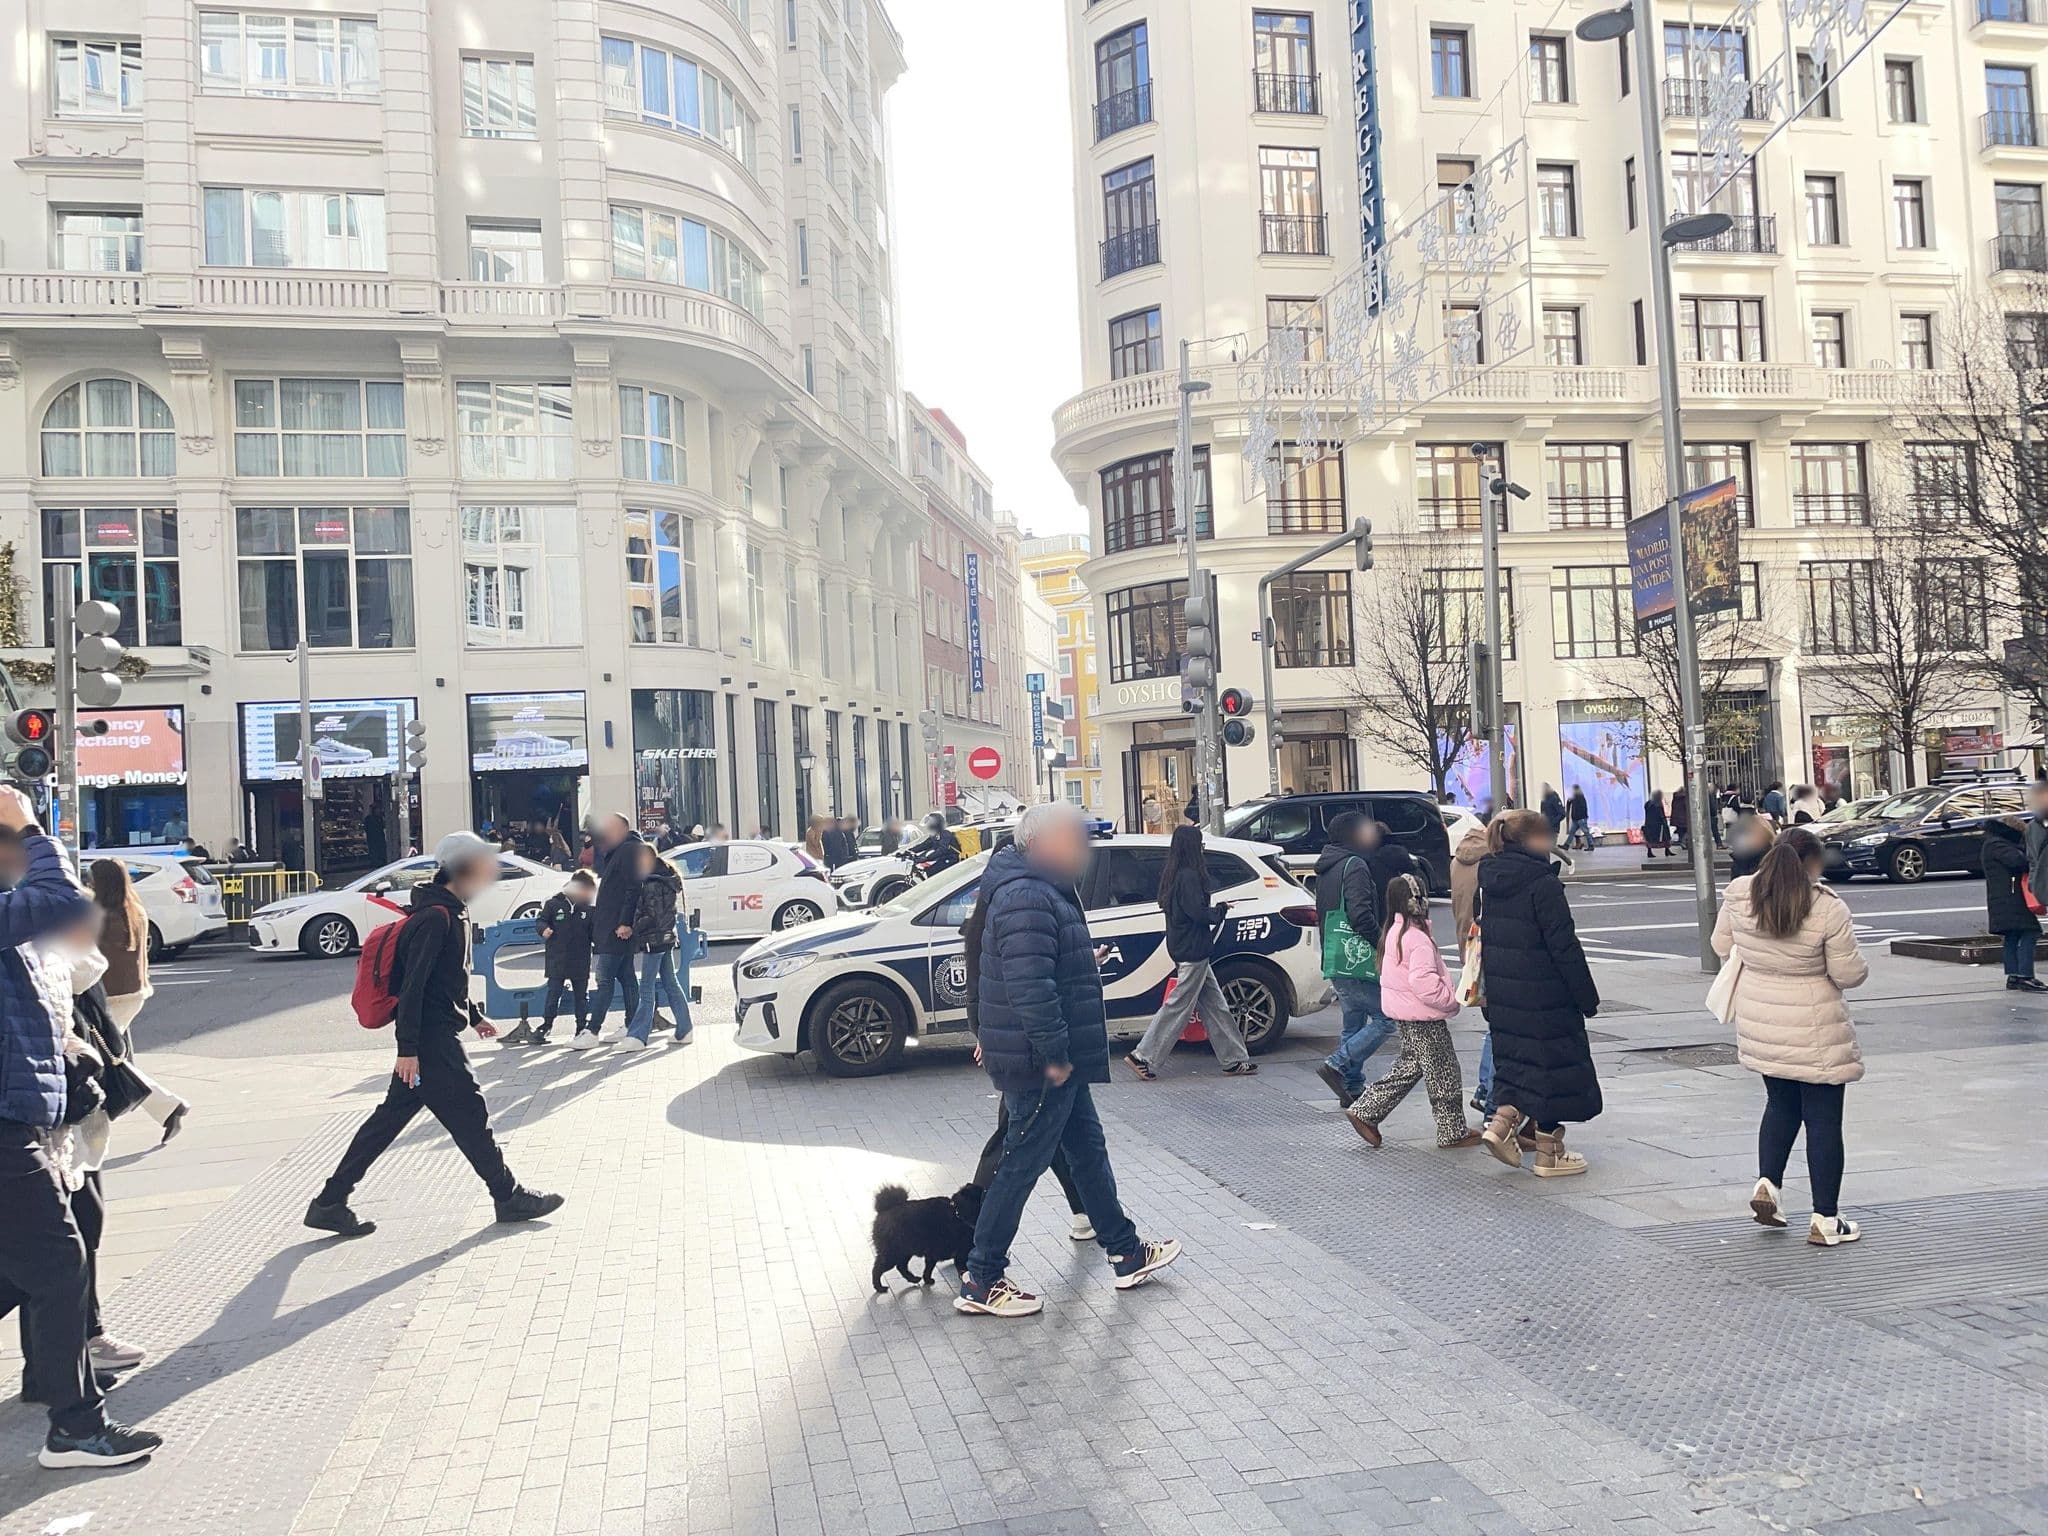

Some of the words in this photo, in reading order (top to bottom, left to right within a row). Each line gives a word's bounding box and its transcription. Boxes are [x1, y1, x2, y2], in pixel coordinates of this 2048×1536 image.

[1649, 554, 1671, 572] POST
[968, 557, 977, 607] HOTEL
[1637, 567, 1672, 590] NAVIDEÑ
[972, 621, 982, 689] AVENIDA
[75, 735, 151, 748] xchange
[641, 749, 718, 759] SKECHERS
[46, 772, 120, 788] Cange
[124, 770, 187, 785] Money
[728, 895, 763, 910] TKE
[1237, 918, 1264, 931] 092
[1236, 930, 1257, 942] 112
